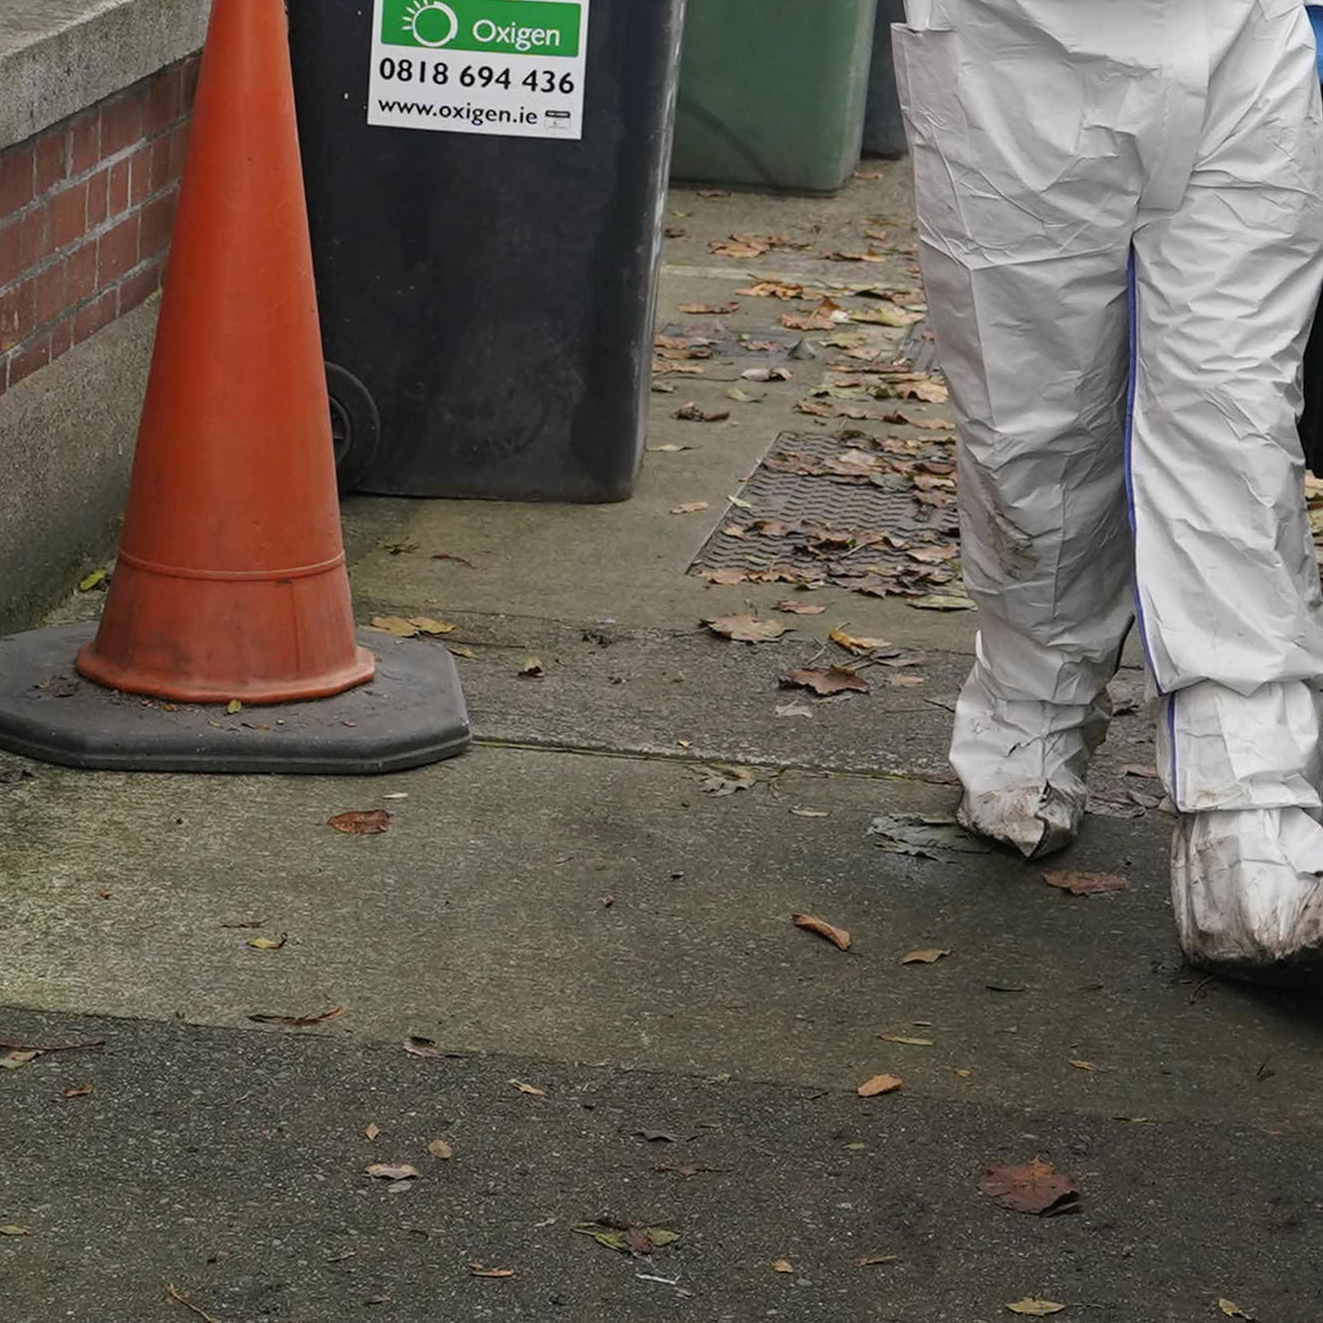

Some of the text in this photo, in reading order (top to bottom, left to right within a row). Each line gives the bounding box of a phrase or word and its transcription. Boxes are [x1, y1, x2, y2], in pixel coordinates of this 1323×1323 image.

[472, 19, 560, 51] Oxigen
[379, 58, 574, 94] 0818 694 436
[378, 99, 538, 125] www.oxigen.ie
